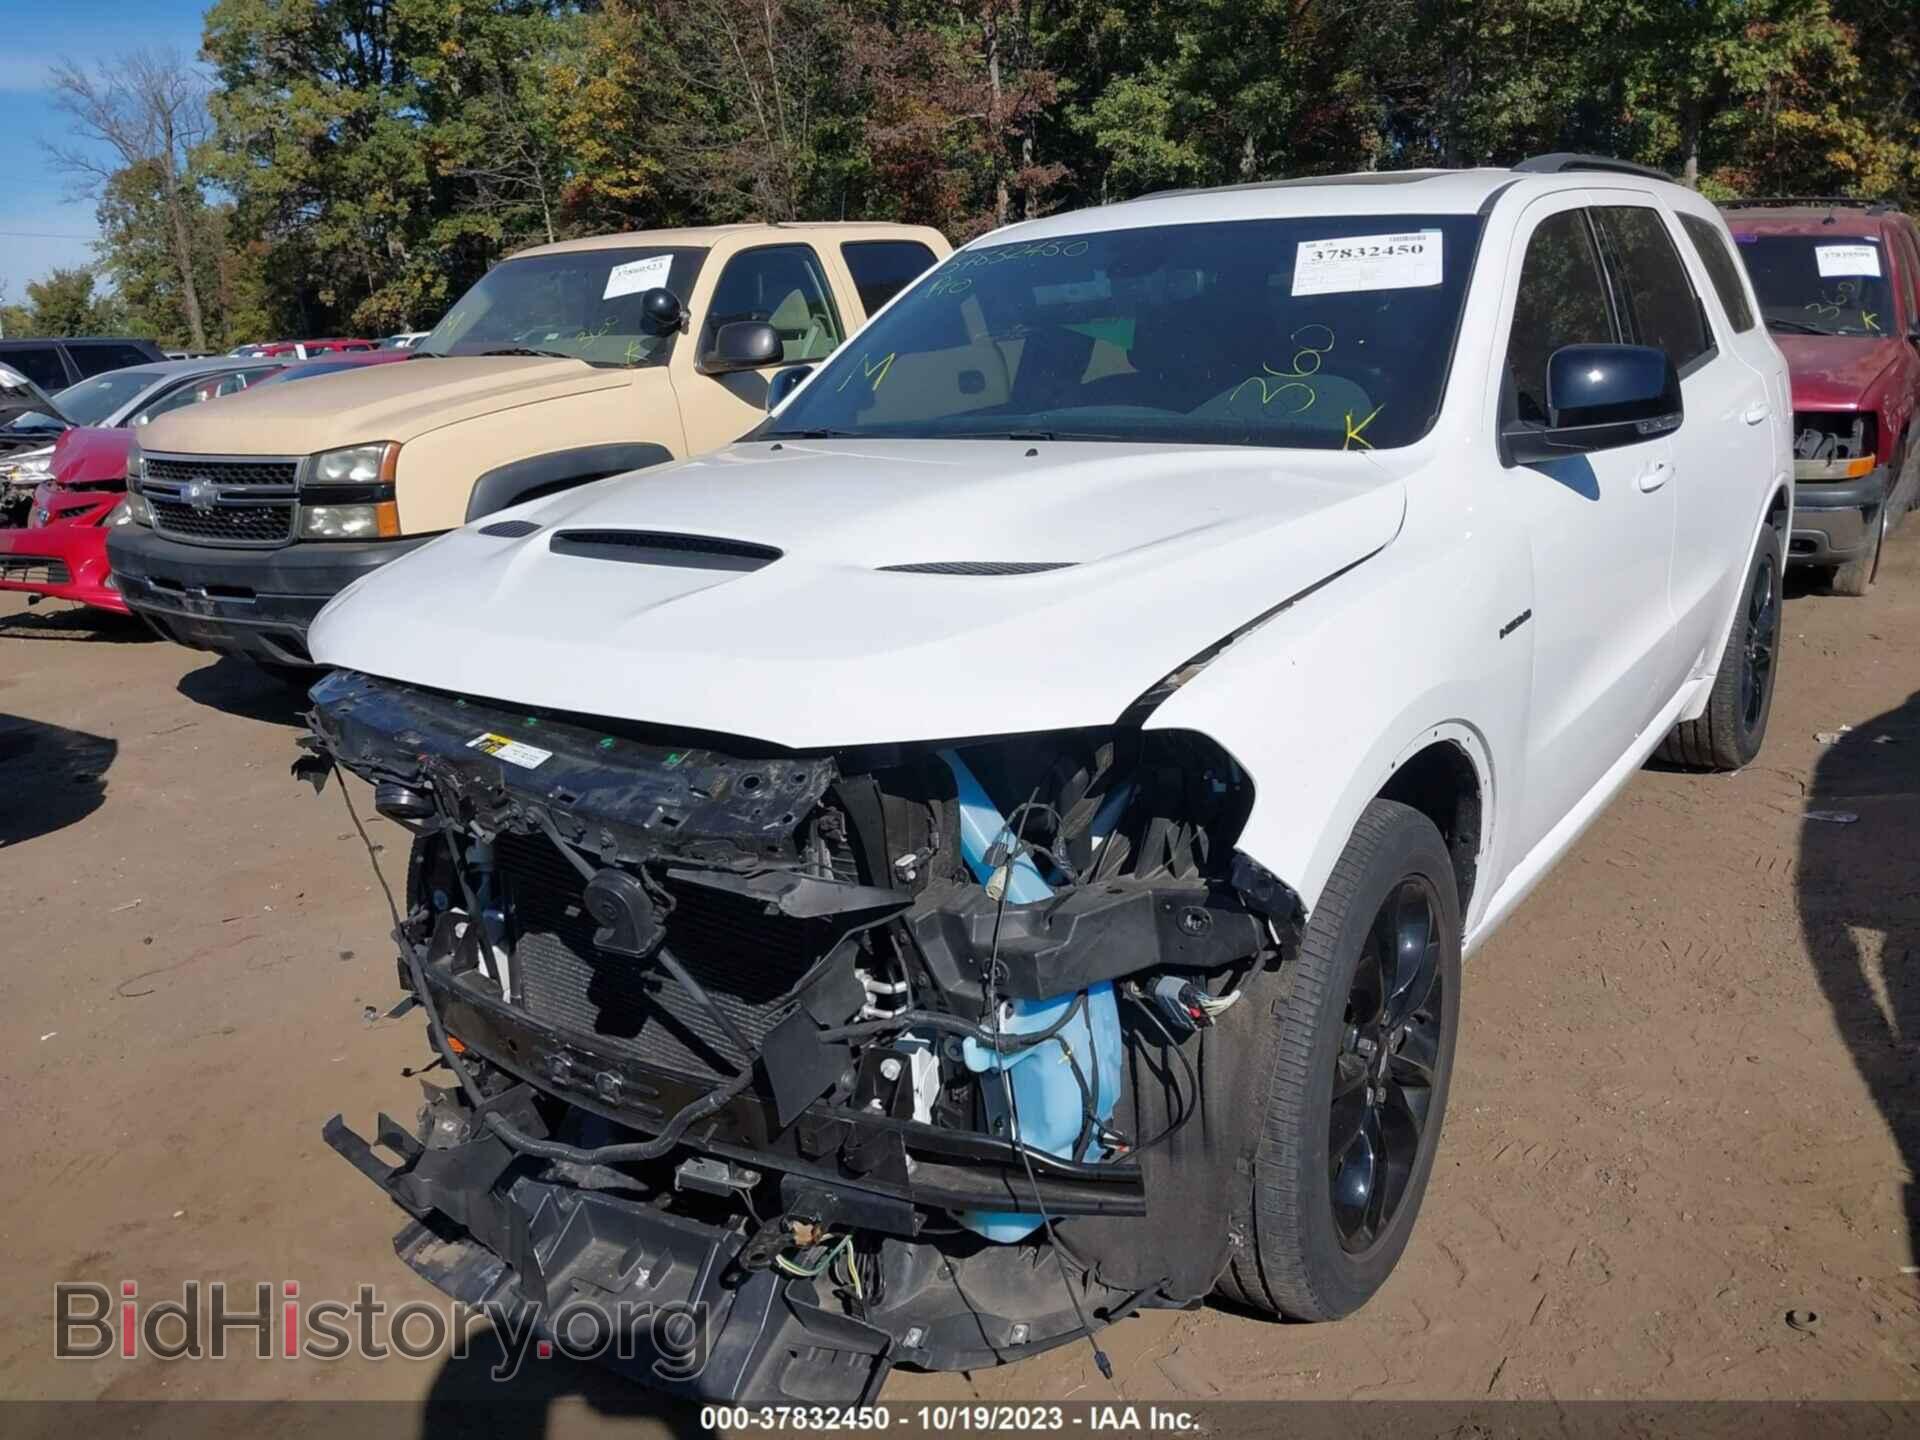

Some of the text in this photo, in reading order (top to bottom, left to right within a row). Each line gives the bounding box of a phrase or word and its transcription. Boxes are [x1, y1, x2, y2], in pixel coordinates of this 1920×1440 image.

[1311, 244, 1424, 262] 37832450
[1862, 311, 1881, 331] K
[625, 340, 649, 364] K
[836, 352, 896, 392] M
[1230, 324, 1335, 413] 360
[1343, 402, 1386, 451] K
